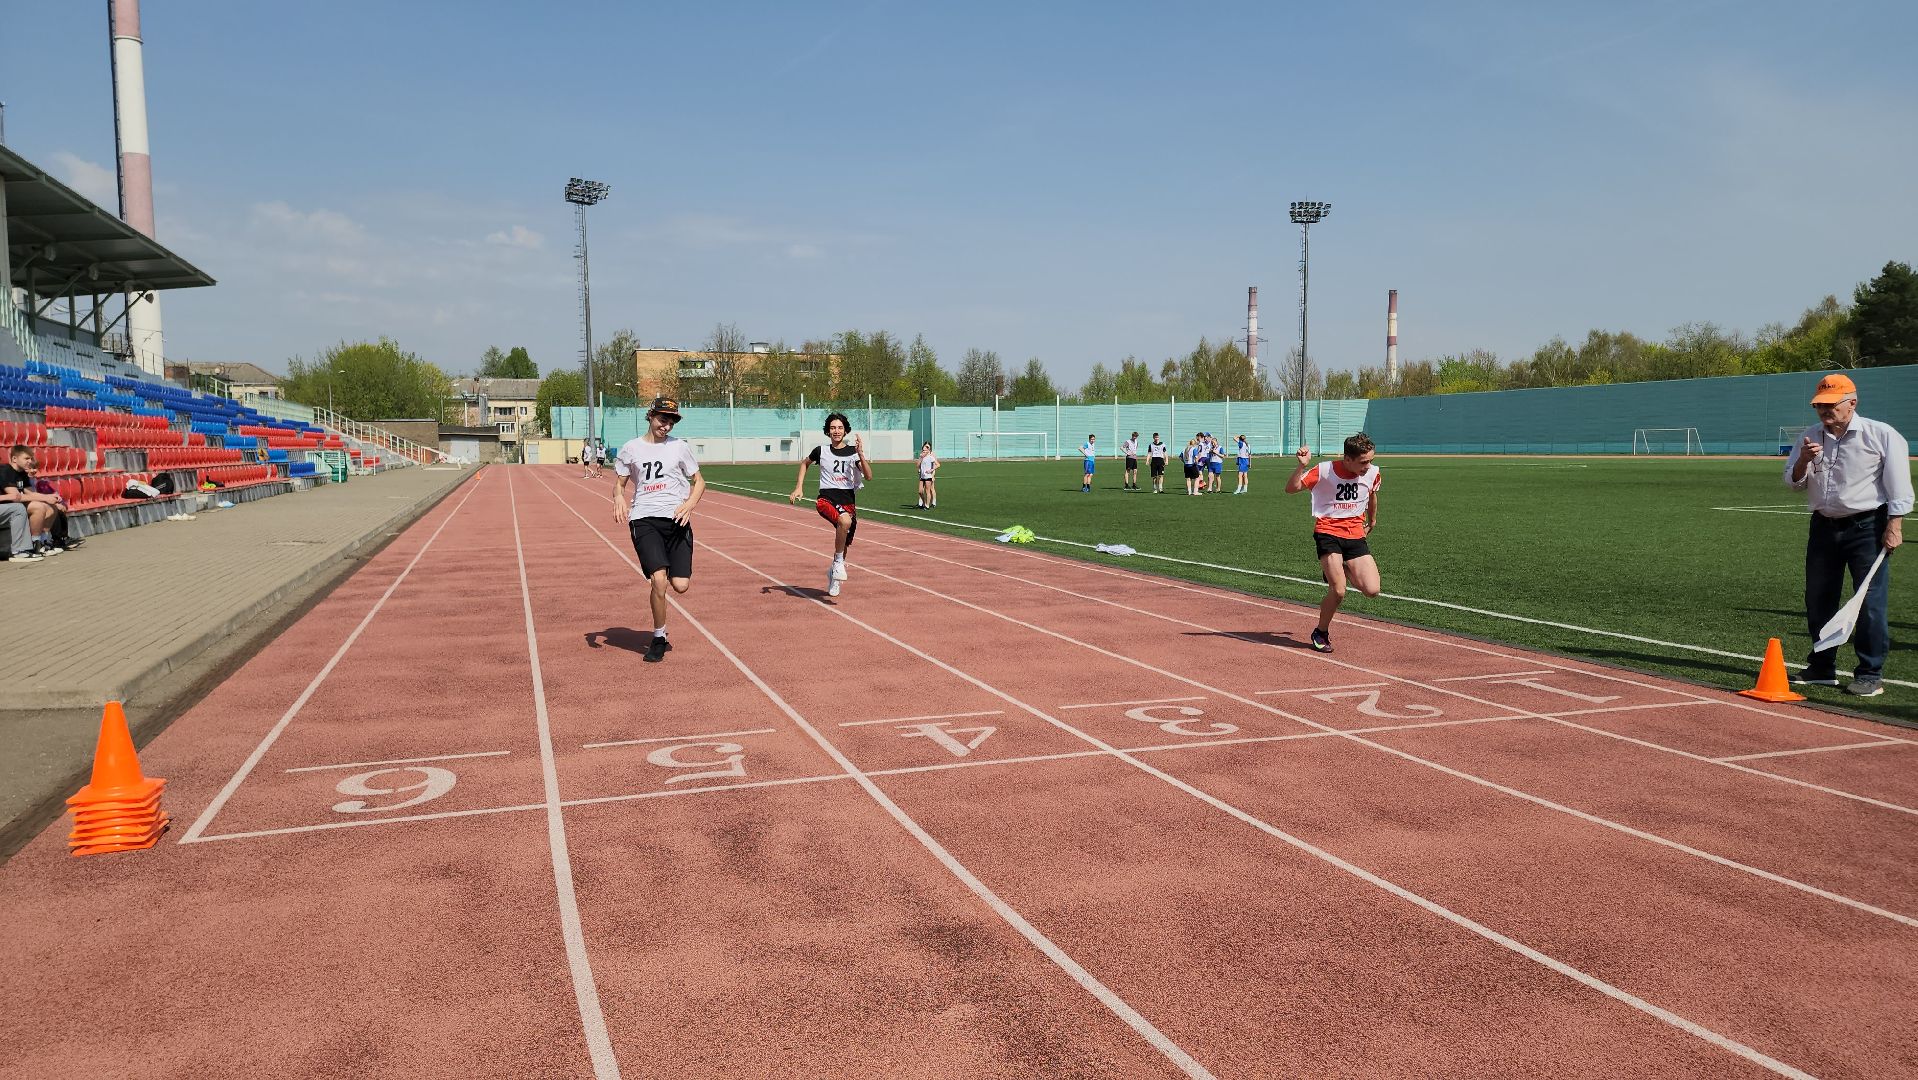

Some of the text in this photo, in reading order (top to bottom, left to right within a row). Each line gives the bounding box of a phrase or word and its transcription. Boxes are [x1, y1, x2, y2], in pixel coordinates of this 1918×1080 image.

[642, 460, 664, 480] 72
[833, 459, 846, 473] 21
[1335, 482, 1359, 501] 288
[1310, 689, 1444, 719] 2
[1487, 678, 1622, 703] 1
[1124, 705, 1239, 736] 3
[894, 722, 998, 757] 4
[646, 742, 747, 785] 5
[332, 766, 456, 813] 6
